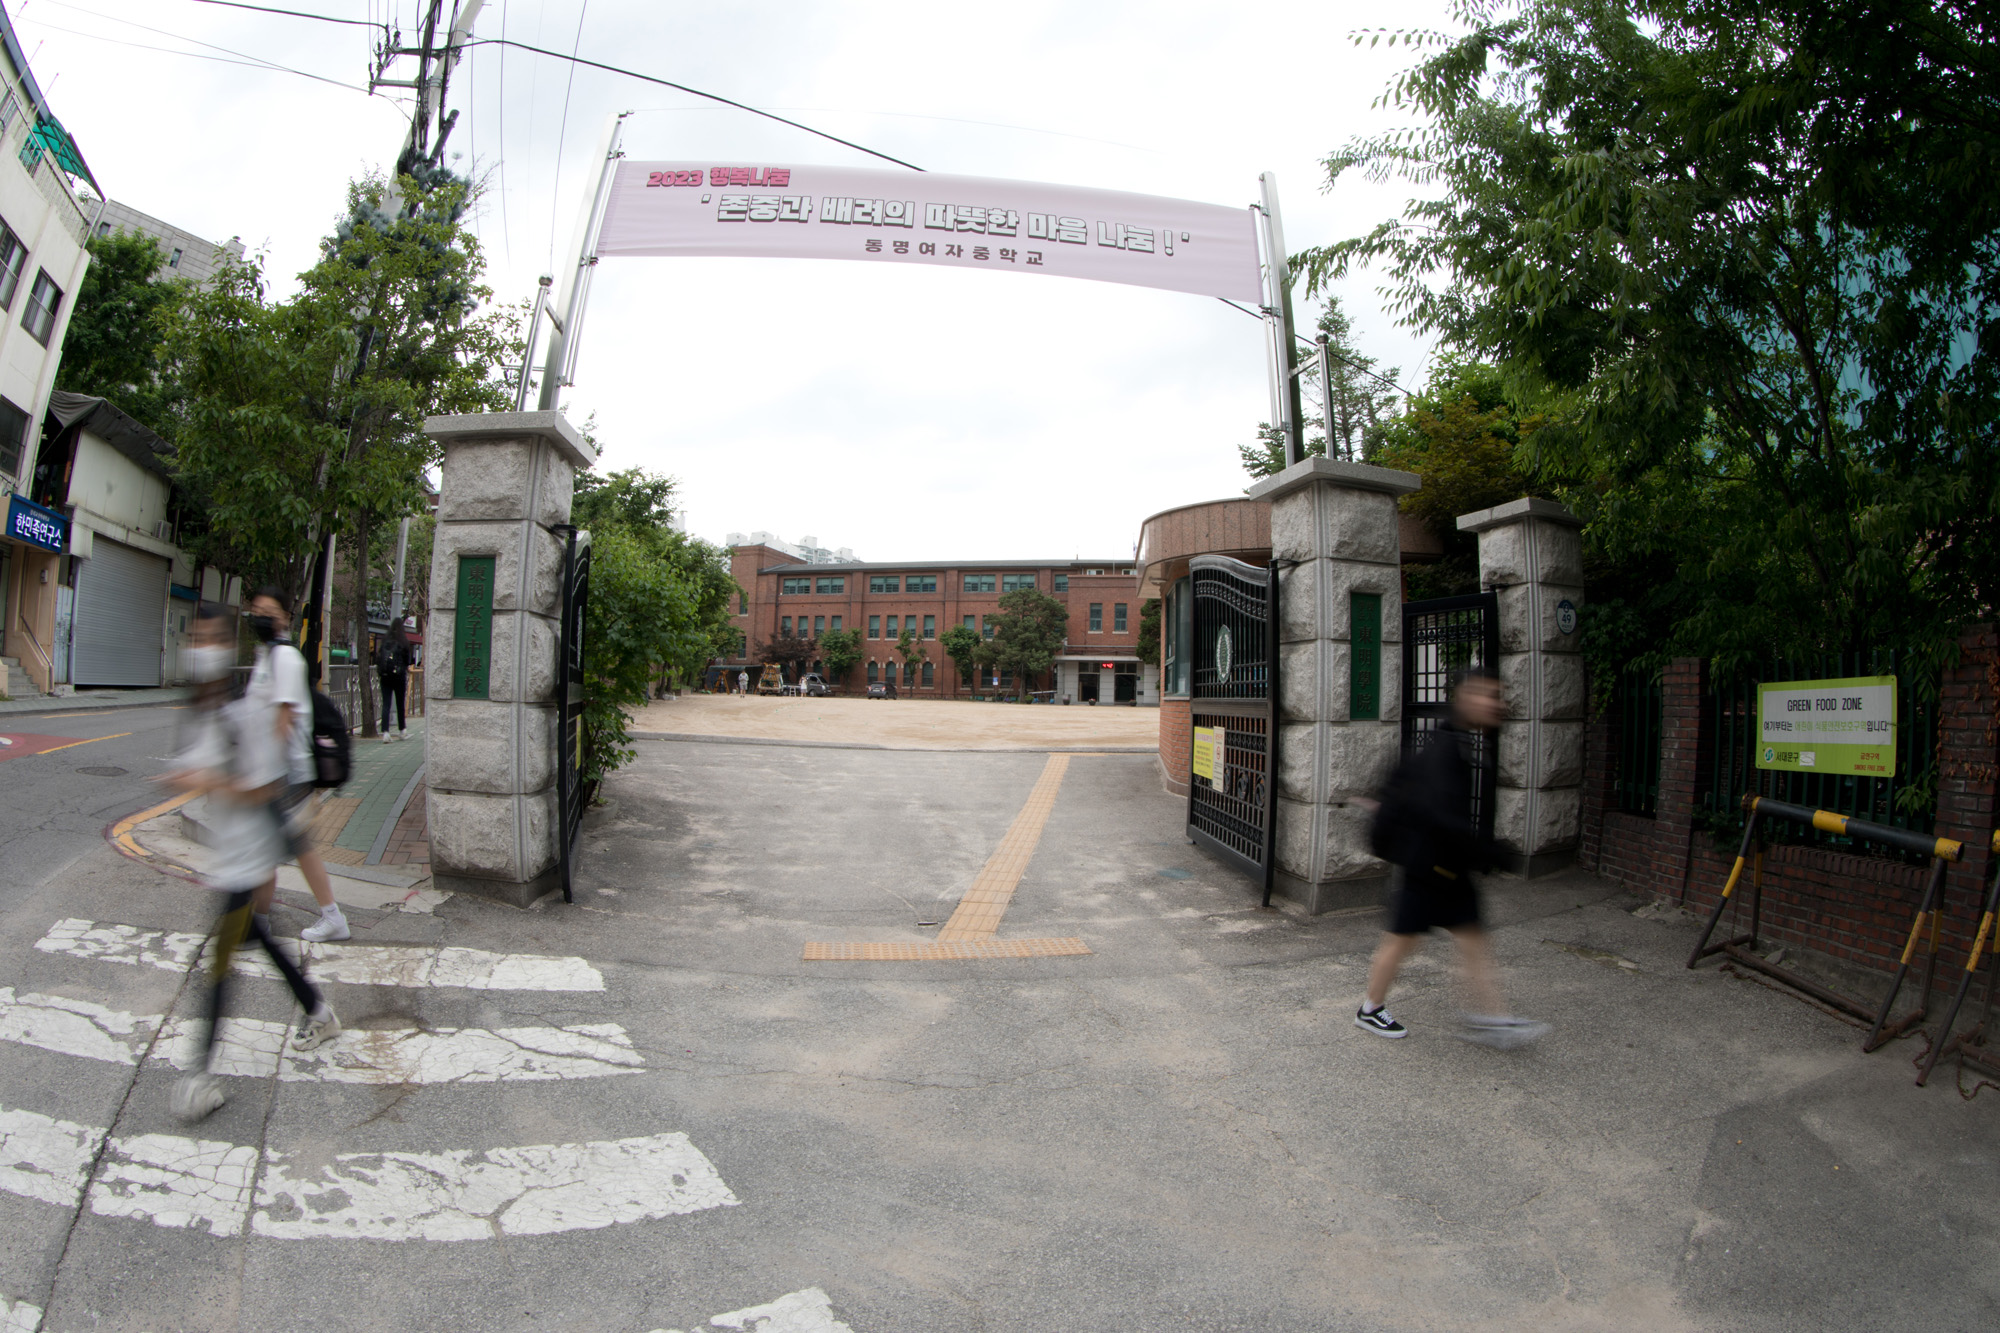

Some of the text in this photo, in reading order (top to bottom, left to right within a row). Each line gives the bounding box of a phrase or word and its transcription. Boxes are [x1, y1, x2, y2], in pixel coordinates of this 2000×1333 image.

[646, 167, 791, 187] 2023 행복나눔
[820, 196, 916, 229] 배려의
[924, 203, 1020, 237] 따뜻한
[1027, 212, 1088, 246] 마음
[865, 238, 1044, 267] 동명여자중학교
[15, 512, 62, 548] 한민족연구소
[464, 564, 487, 694] 東明女子中學校
[1562, 614, 1572, 624] 49
[1787, 697, 1862, 712] GREEN FOOD ZONE
[1763, 721, 1793, 732] 여기부터는
[1775, 751, 1799, 763] 서대문구
